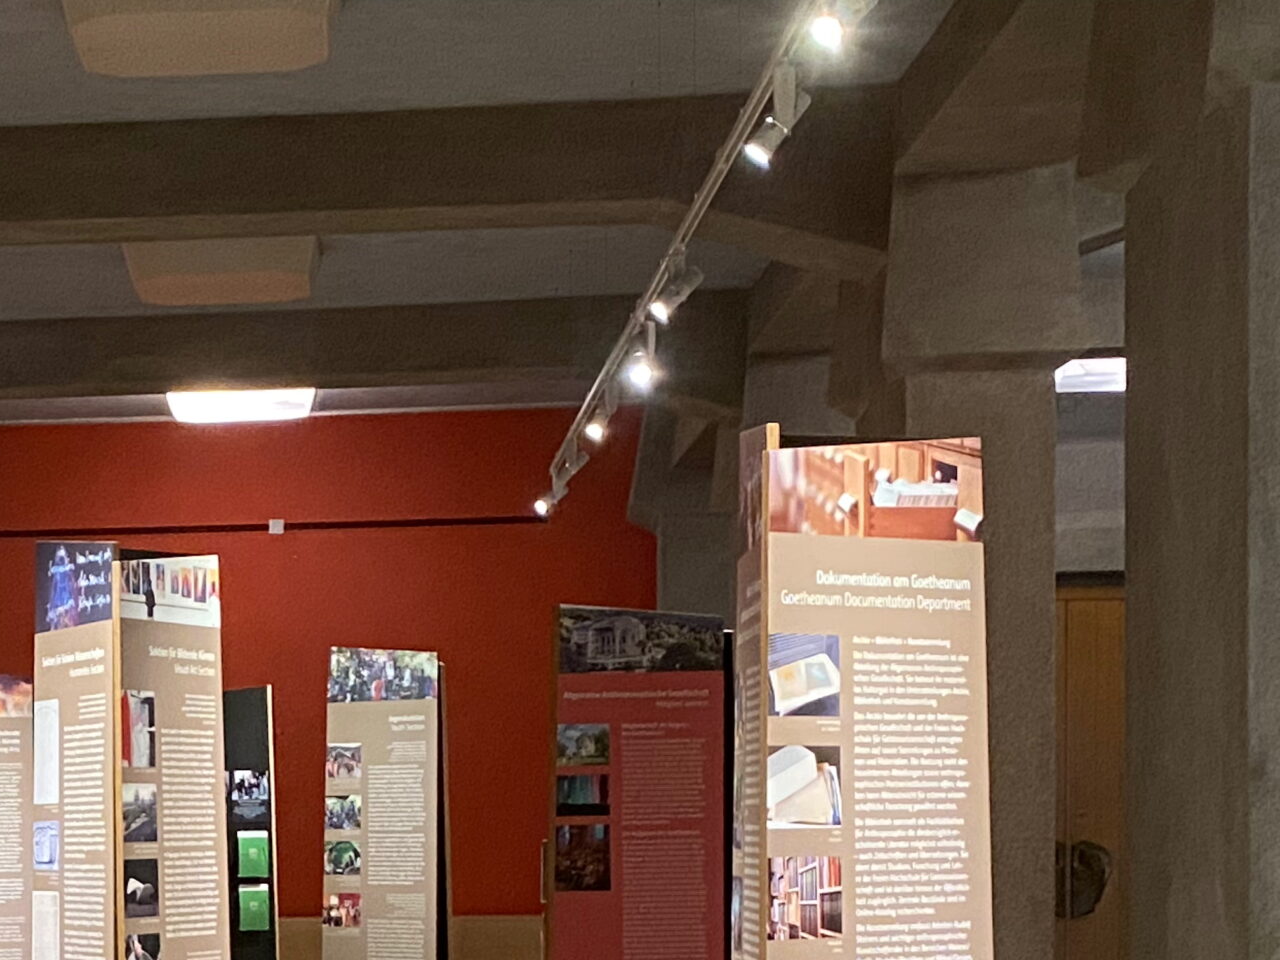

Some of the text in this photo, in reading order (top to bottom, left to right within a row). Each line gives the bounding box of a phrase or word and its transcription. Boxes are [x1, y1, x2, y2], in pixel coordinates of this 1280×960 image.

[816, 570, 971, 590] Dokumentation am Goetheanum
[780, 589, 971, 613] Goetheanum Documentation Department
